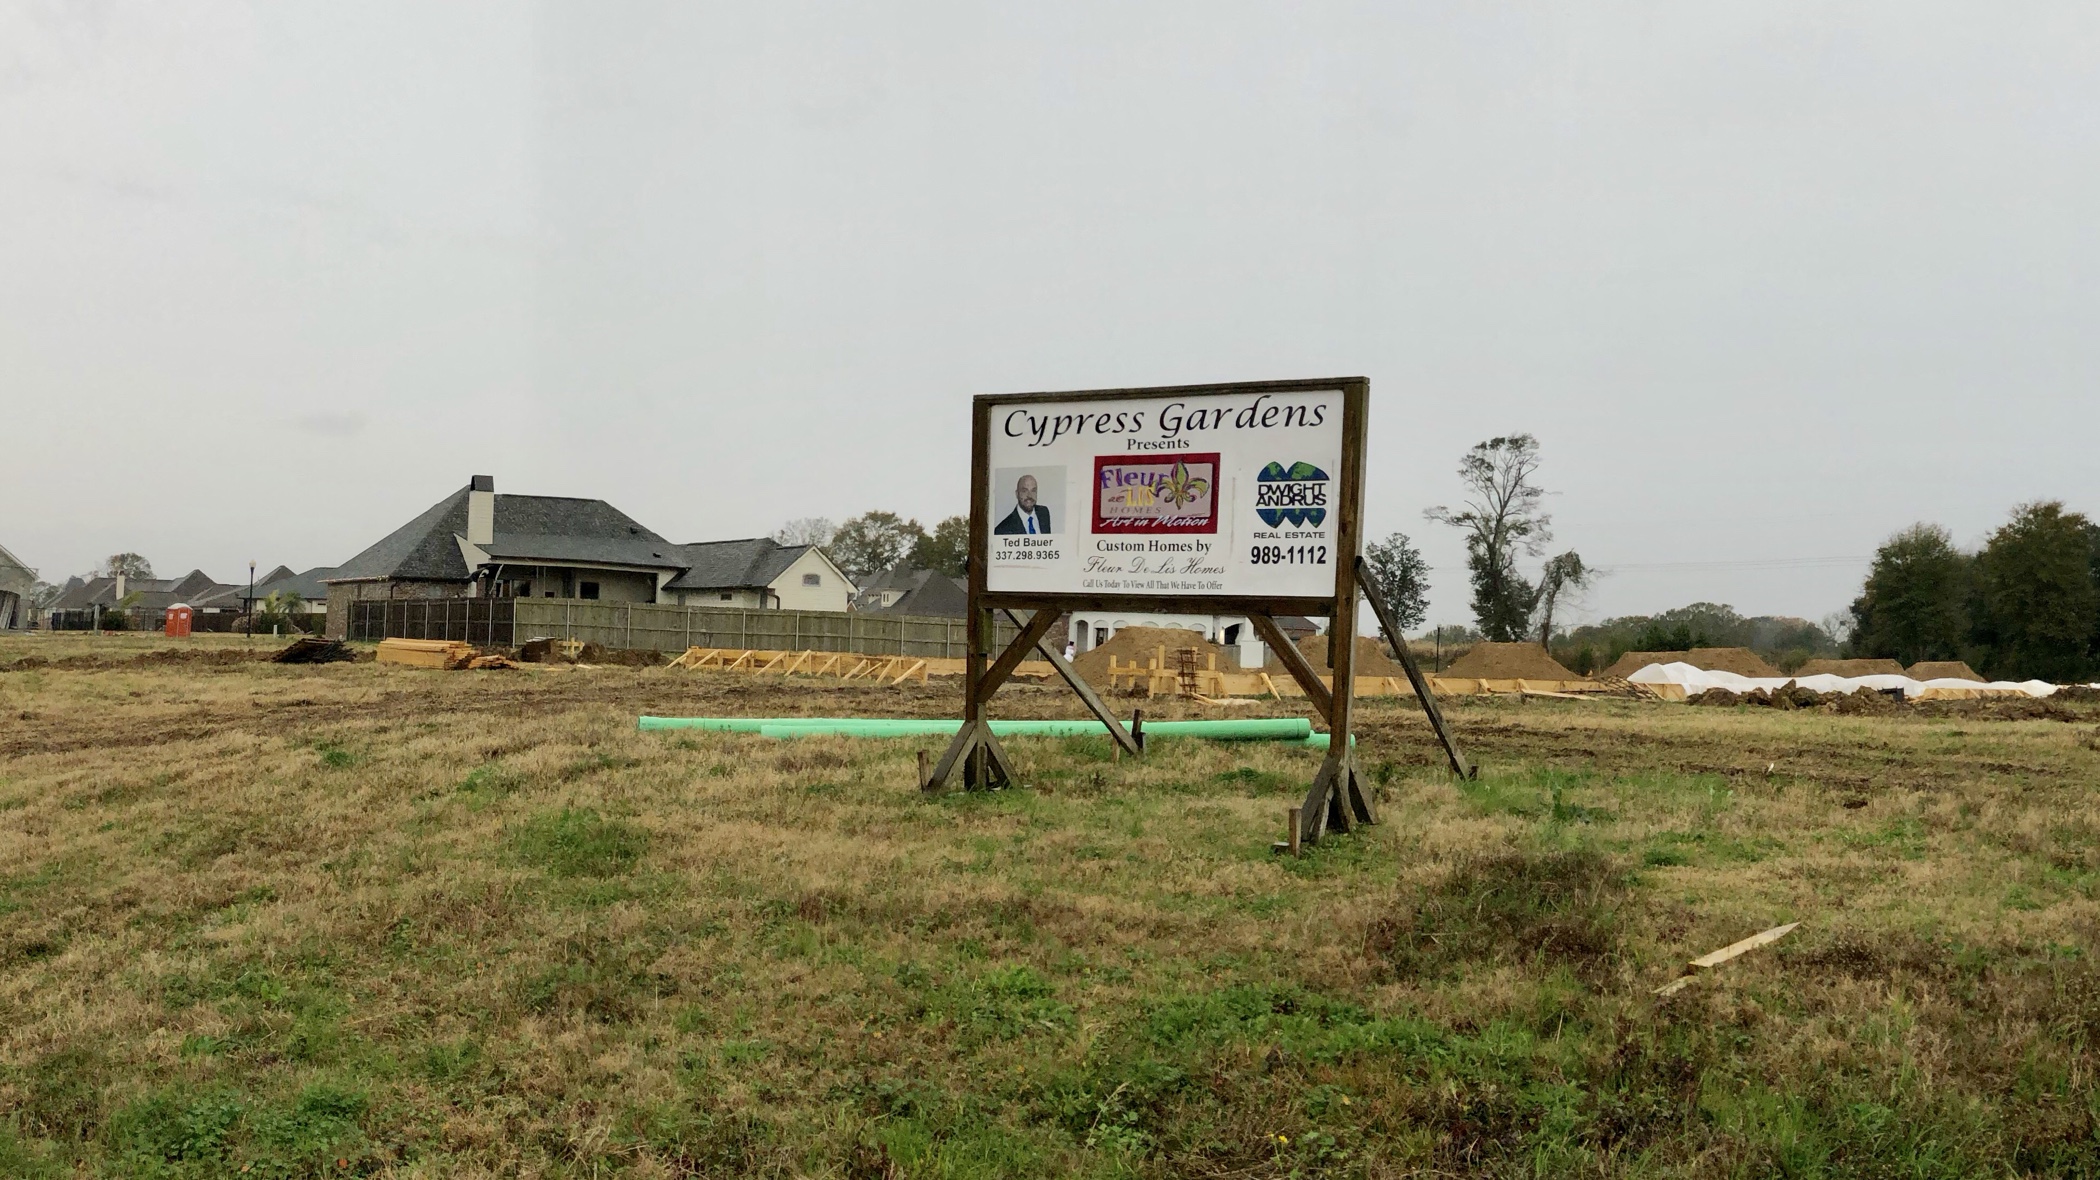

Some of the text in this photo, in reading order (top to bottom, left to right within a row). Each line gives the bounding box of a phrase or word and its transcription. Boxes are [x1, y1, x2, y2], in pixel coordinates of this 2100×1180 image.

[1004, 395, 1327, 447] Cypress Gardens
[1127, 437, 1190, 450] Presents
[1100, 467, 1169, 490] Fleur
[1258, 483, 1326, 496] DWIGHT
[1255, 493, 1327, 507] ANDRUS
[1109, 506, 1161, 514] HOMES
[1100, 516, 1134, 528] Art
[1151, 515, 1209, 528] Motion
[1285, 531, 1326, 539] ESTATE
[1003, 537, 1053, 547] Ted Bauer
[1096, 539, 1212, 555] Custom Homes by
[995, 550, 1060, 560] 337.298.9365
[1250, 545, 1327, 565] 989-1112
[1083, 555, 1226, 574] Fleur De Lis Homes
[1082, 579, 1223, 590] Call Us Today To View All That We Have To Offer
